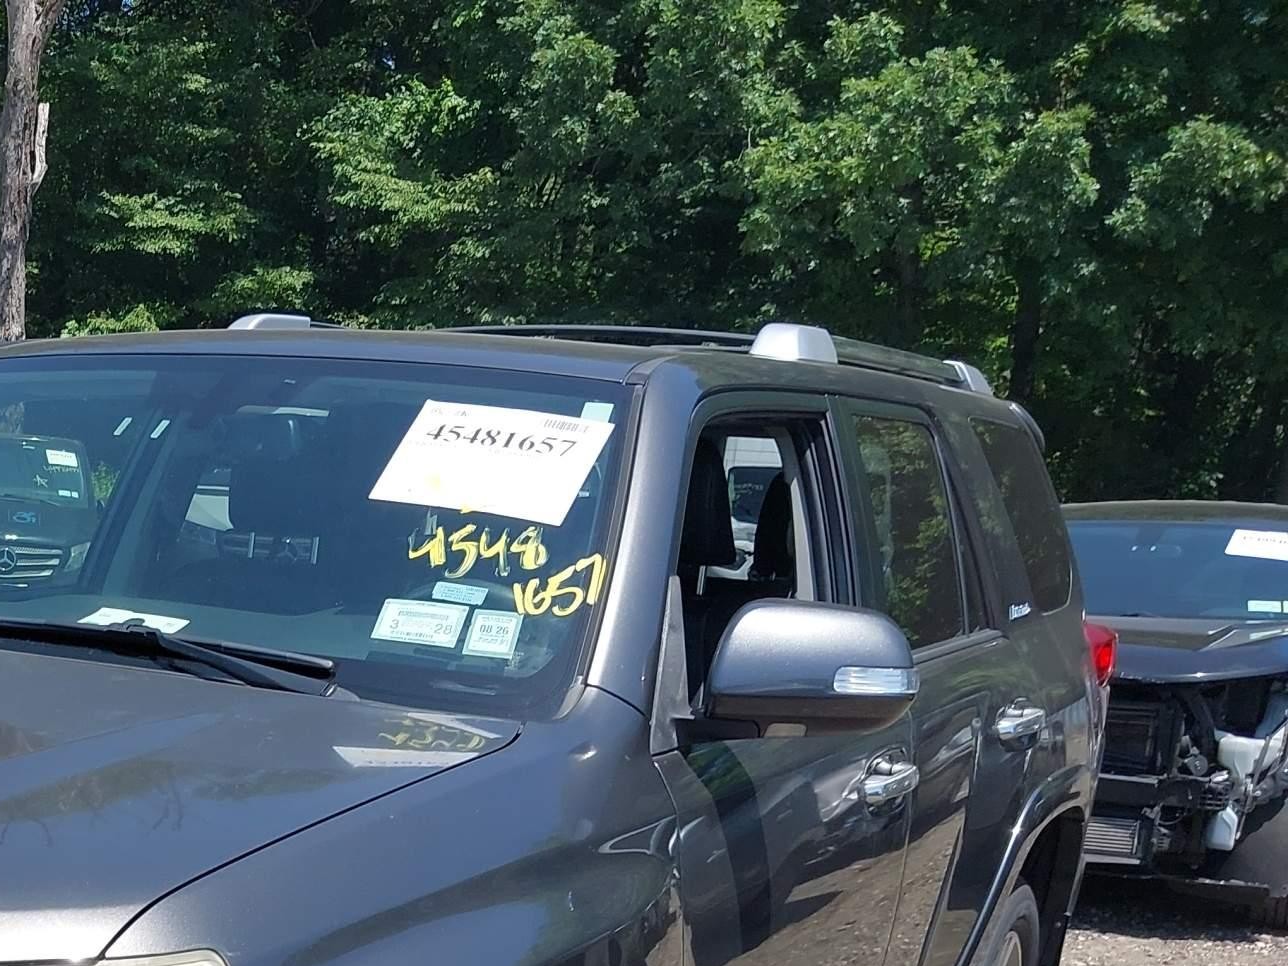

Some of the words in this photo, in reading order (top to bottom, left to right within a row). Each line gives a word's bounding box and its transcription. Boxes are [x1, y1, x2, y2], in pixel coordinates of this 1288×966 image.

[426, 423, 578, 458] 45481657
[407, 523, 548, 578] 4548
[512, 552, 608, 617] 1657
[389, 618, 400, 630] 3
[433, 623, 454, 636] 28
[495, 625, 510, 636] 26
